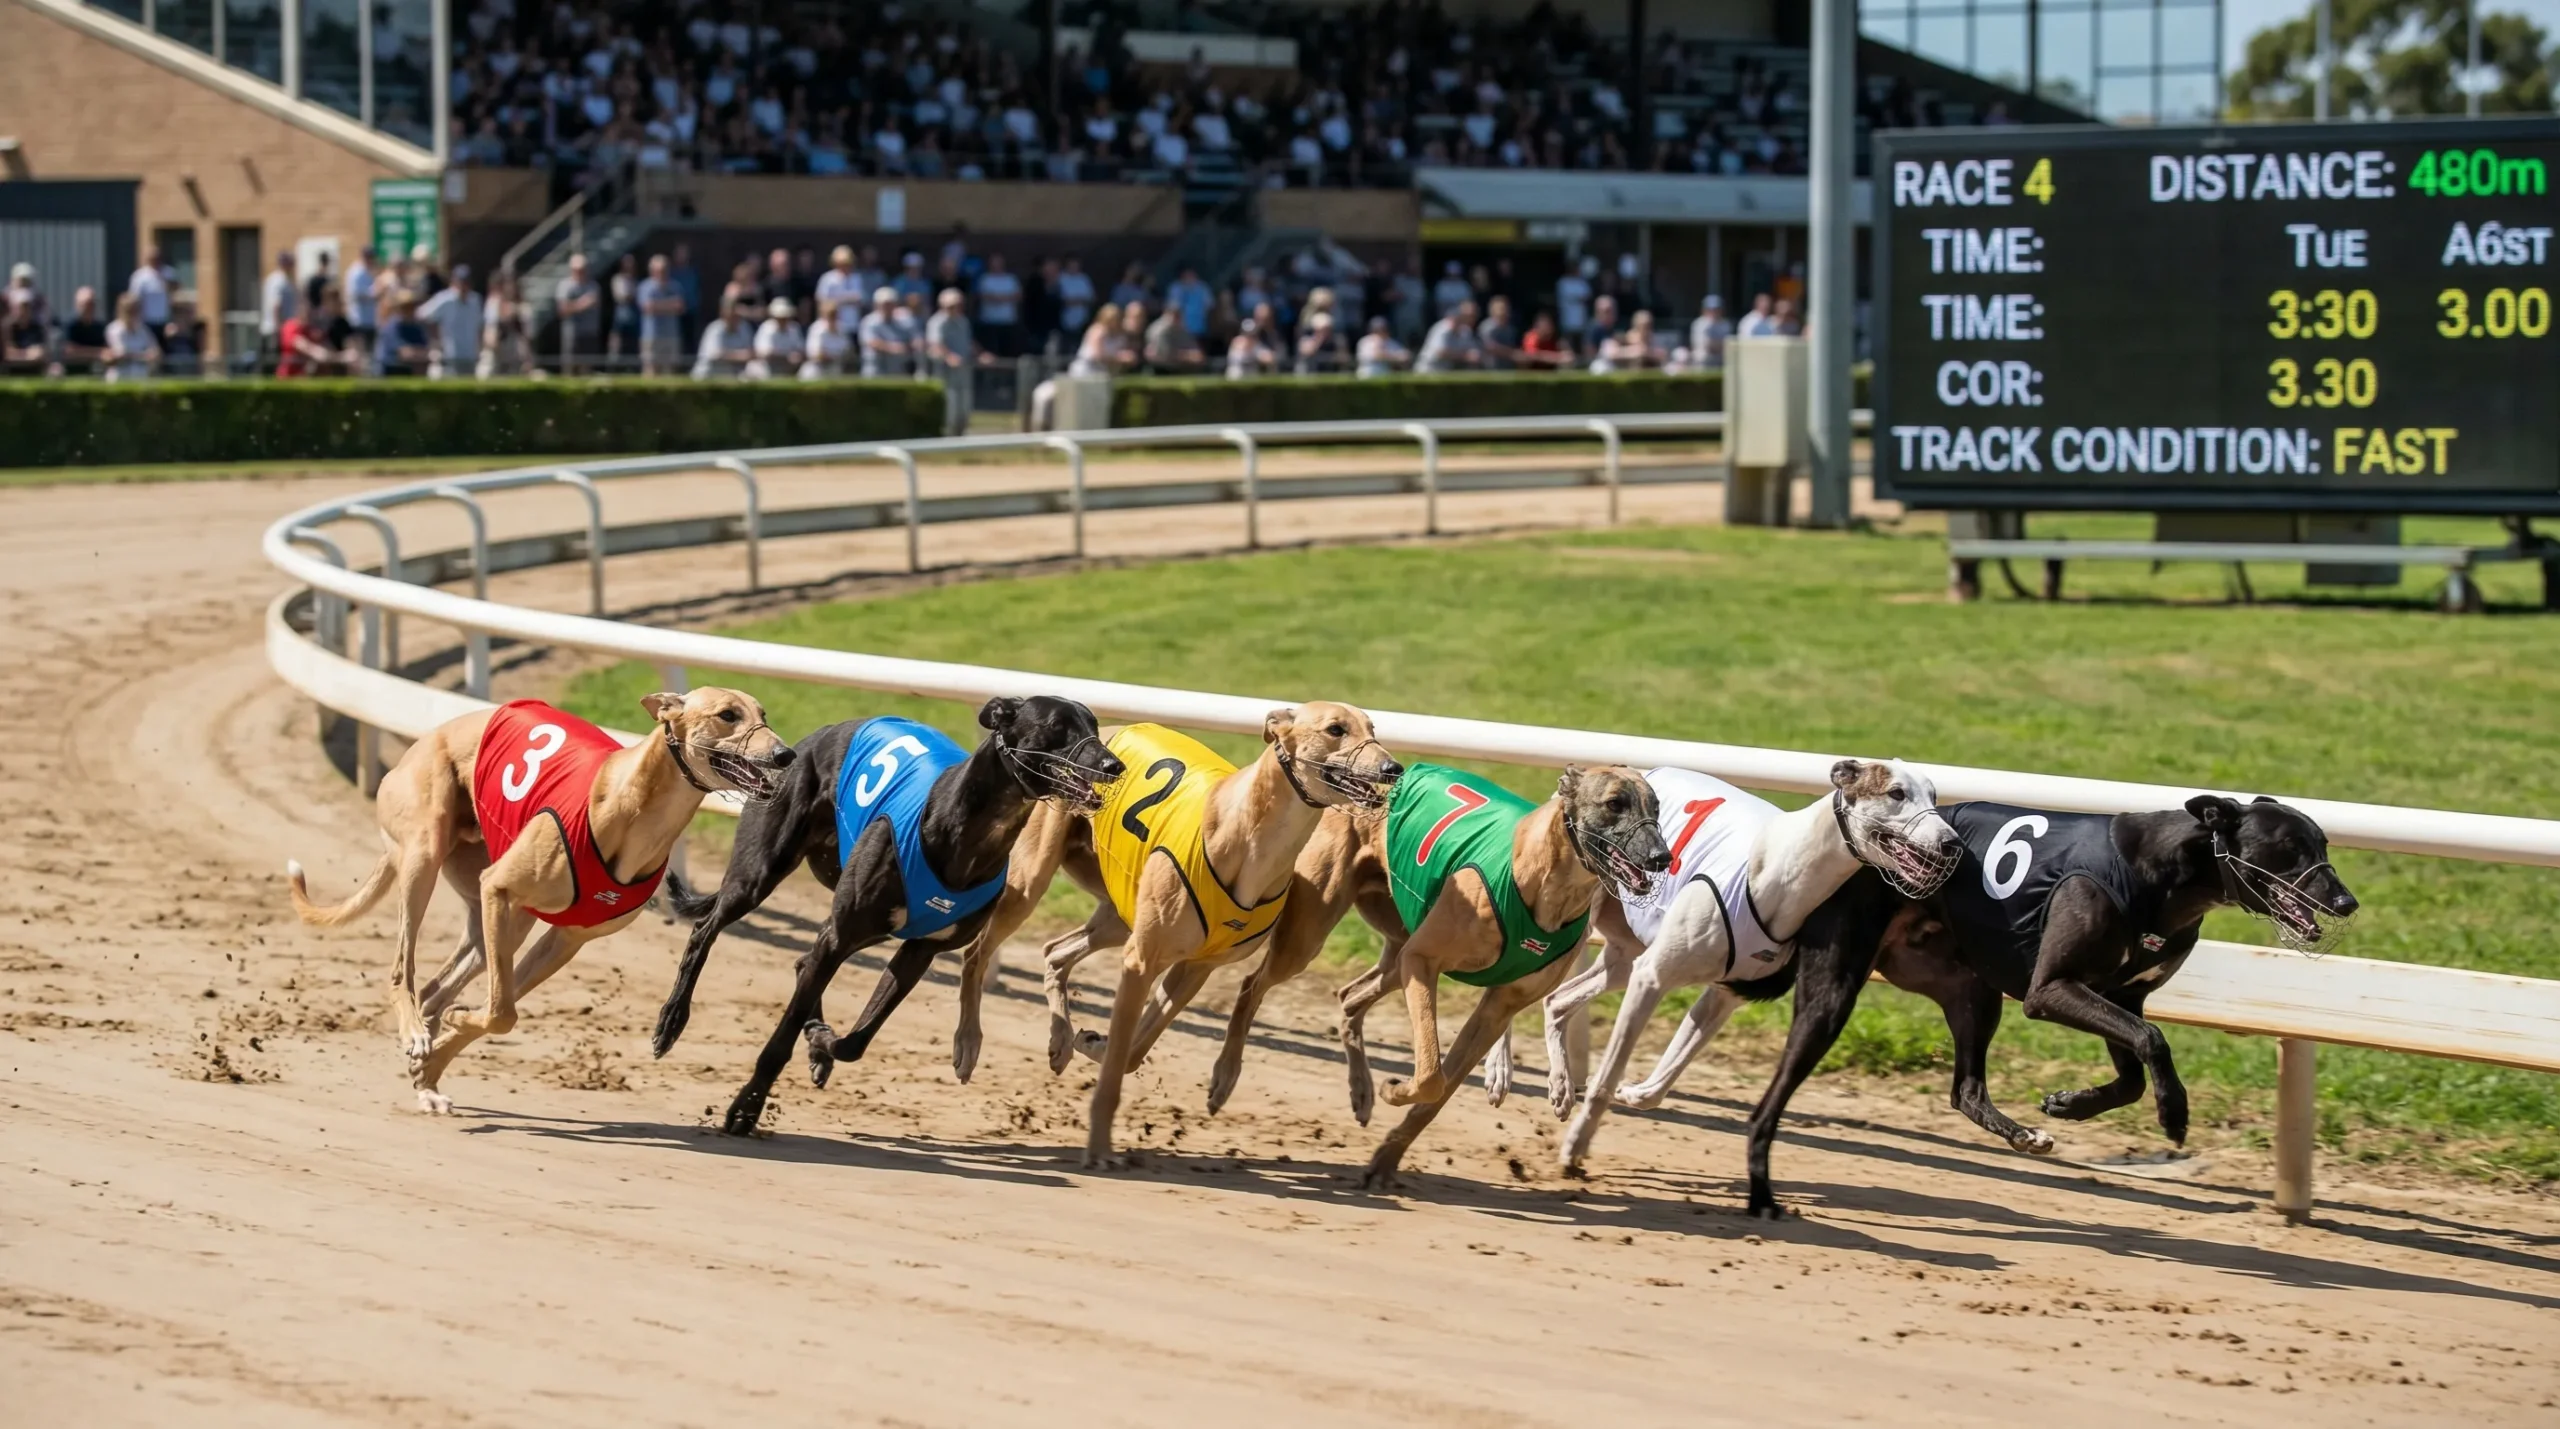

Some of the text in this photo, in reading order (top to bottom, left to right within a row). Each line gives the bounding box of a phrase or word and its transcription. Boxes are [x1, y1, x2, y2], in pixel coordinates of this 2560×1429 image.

[1893, 158, 2055, 207] RACE 4
[2150, 149, 2546, 203] DISTANCE: 480m
[1922, 227, 2045, 274] TIME:
[1922, 294, 2045, 341] TIME:
[2268, 288, 2551, 339] 3:30 3.00
[1937, 360, 2044, 407] COR:
[2268, 358, 2378, 408] 3.30
[1891, 425, 2458, 475] TRACK CONDITION: FAST
[501, 723, 567, 802] 3
[855, 735, 930, 808] 5
[1121, 757, 1187, 843] 2
[1415, 782, 1490, 867] 7
[1668, 797, 1725, 876] 1
[1982, 814, 2050, 900] 6
